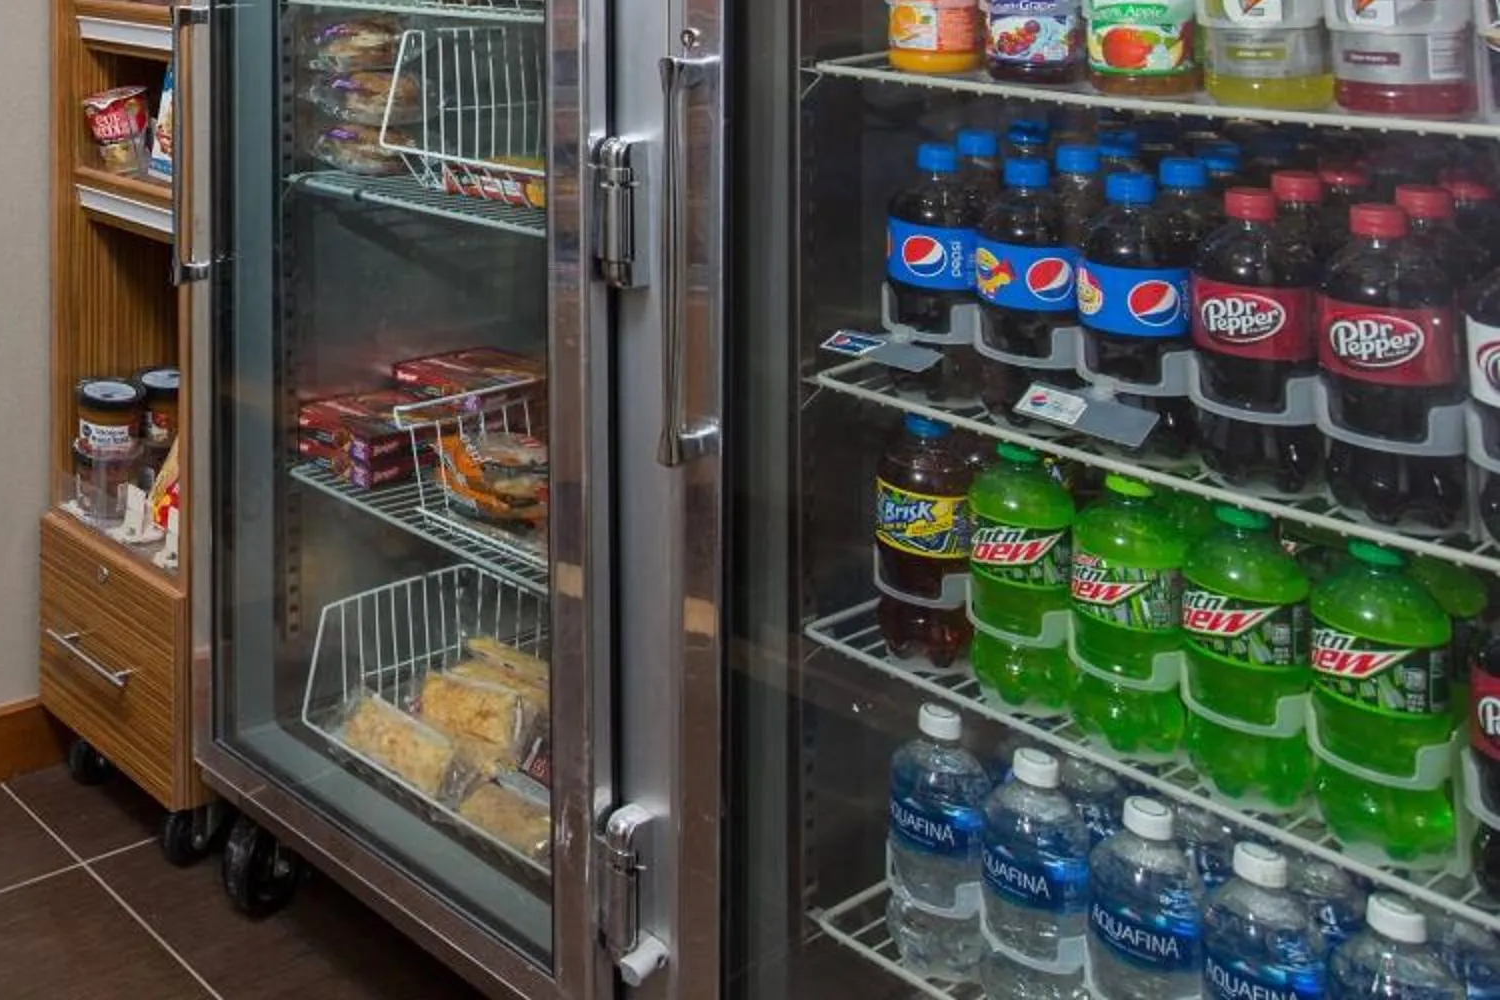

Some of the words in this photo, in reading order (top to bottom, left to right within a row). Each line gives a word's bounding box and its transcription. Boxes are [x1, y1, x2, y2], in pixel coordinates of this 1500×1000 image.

[1207, 299, 1279, 336] Pepper
[1226, 298, 1257, 317] Dr
[1337, 321, 1417, 360] Pepper
[1357, 320, 1394, 340] Dr
[884, 501, 933, 523] Brisk
[891, 800, 955, 847] QUAFINA
[982, 851, 1051, 901] QUAFINA
[1091, 903, 1180, 960] AQUAFINA
